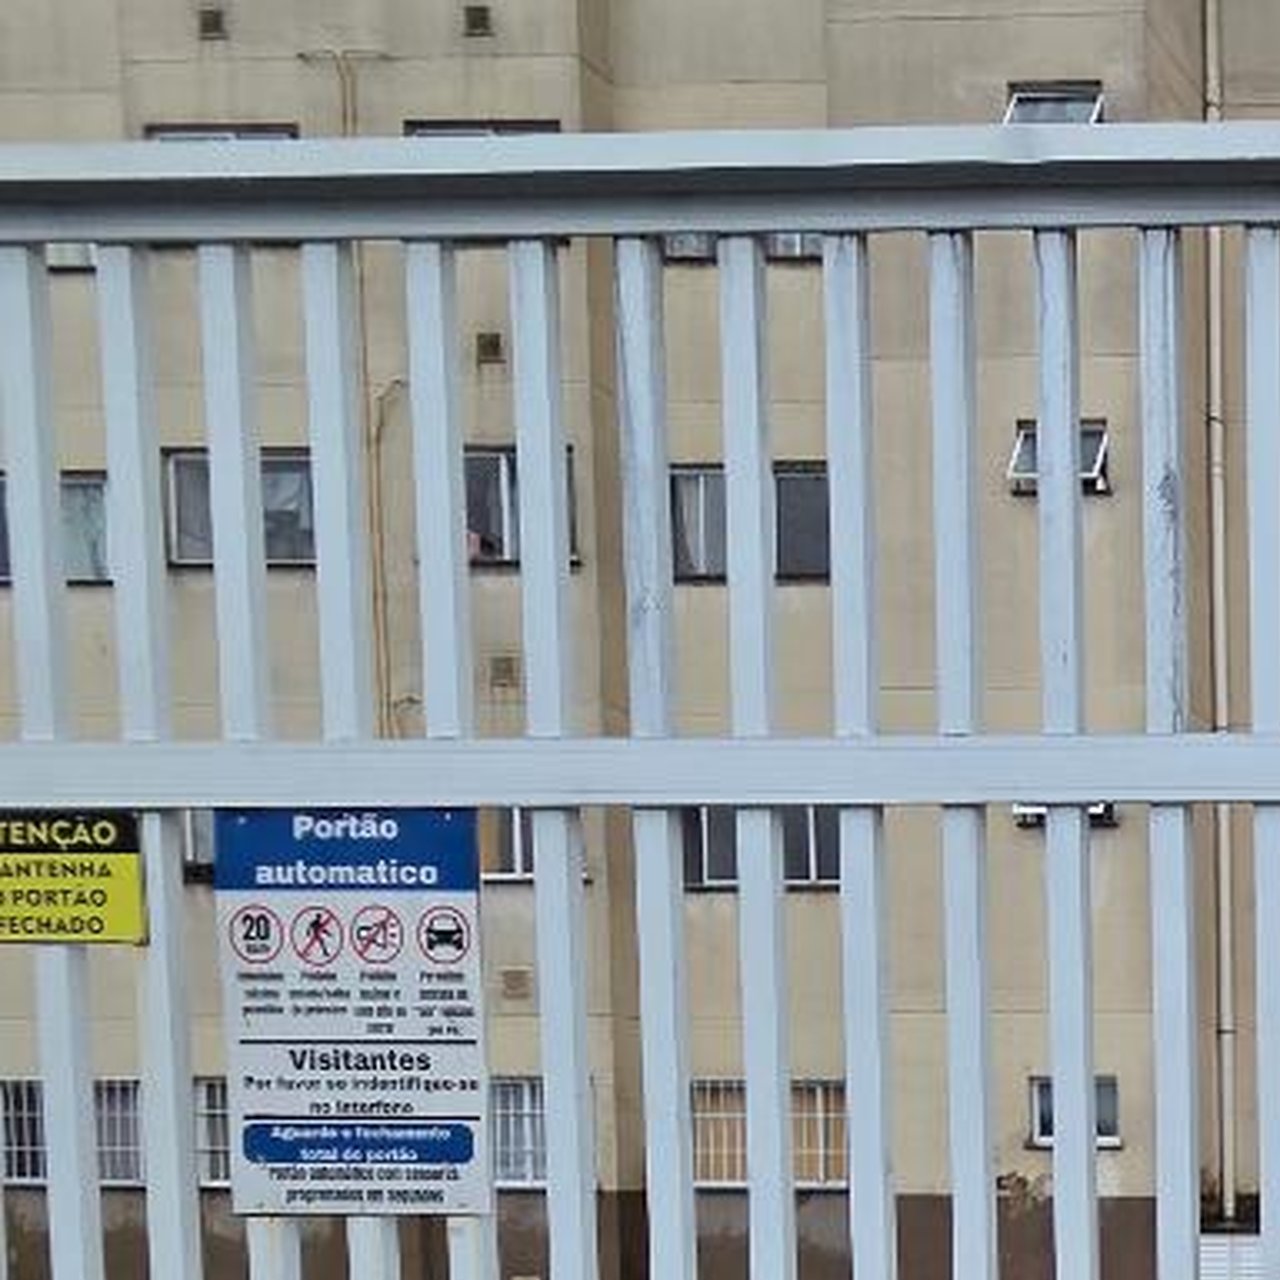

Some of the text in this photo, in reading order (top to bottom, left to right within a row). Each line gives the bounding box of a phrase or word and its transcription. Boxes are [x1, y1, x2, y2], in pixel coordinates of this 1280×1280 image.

[292, 812, 400, 841] Portão
[255, 858, 439, 885] automatico
[241, 913, 271, 941] 20
[288, 1049, 432, 1071] Visitantes
